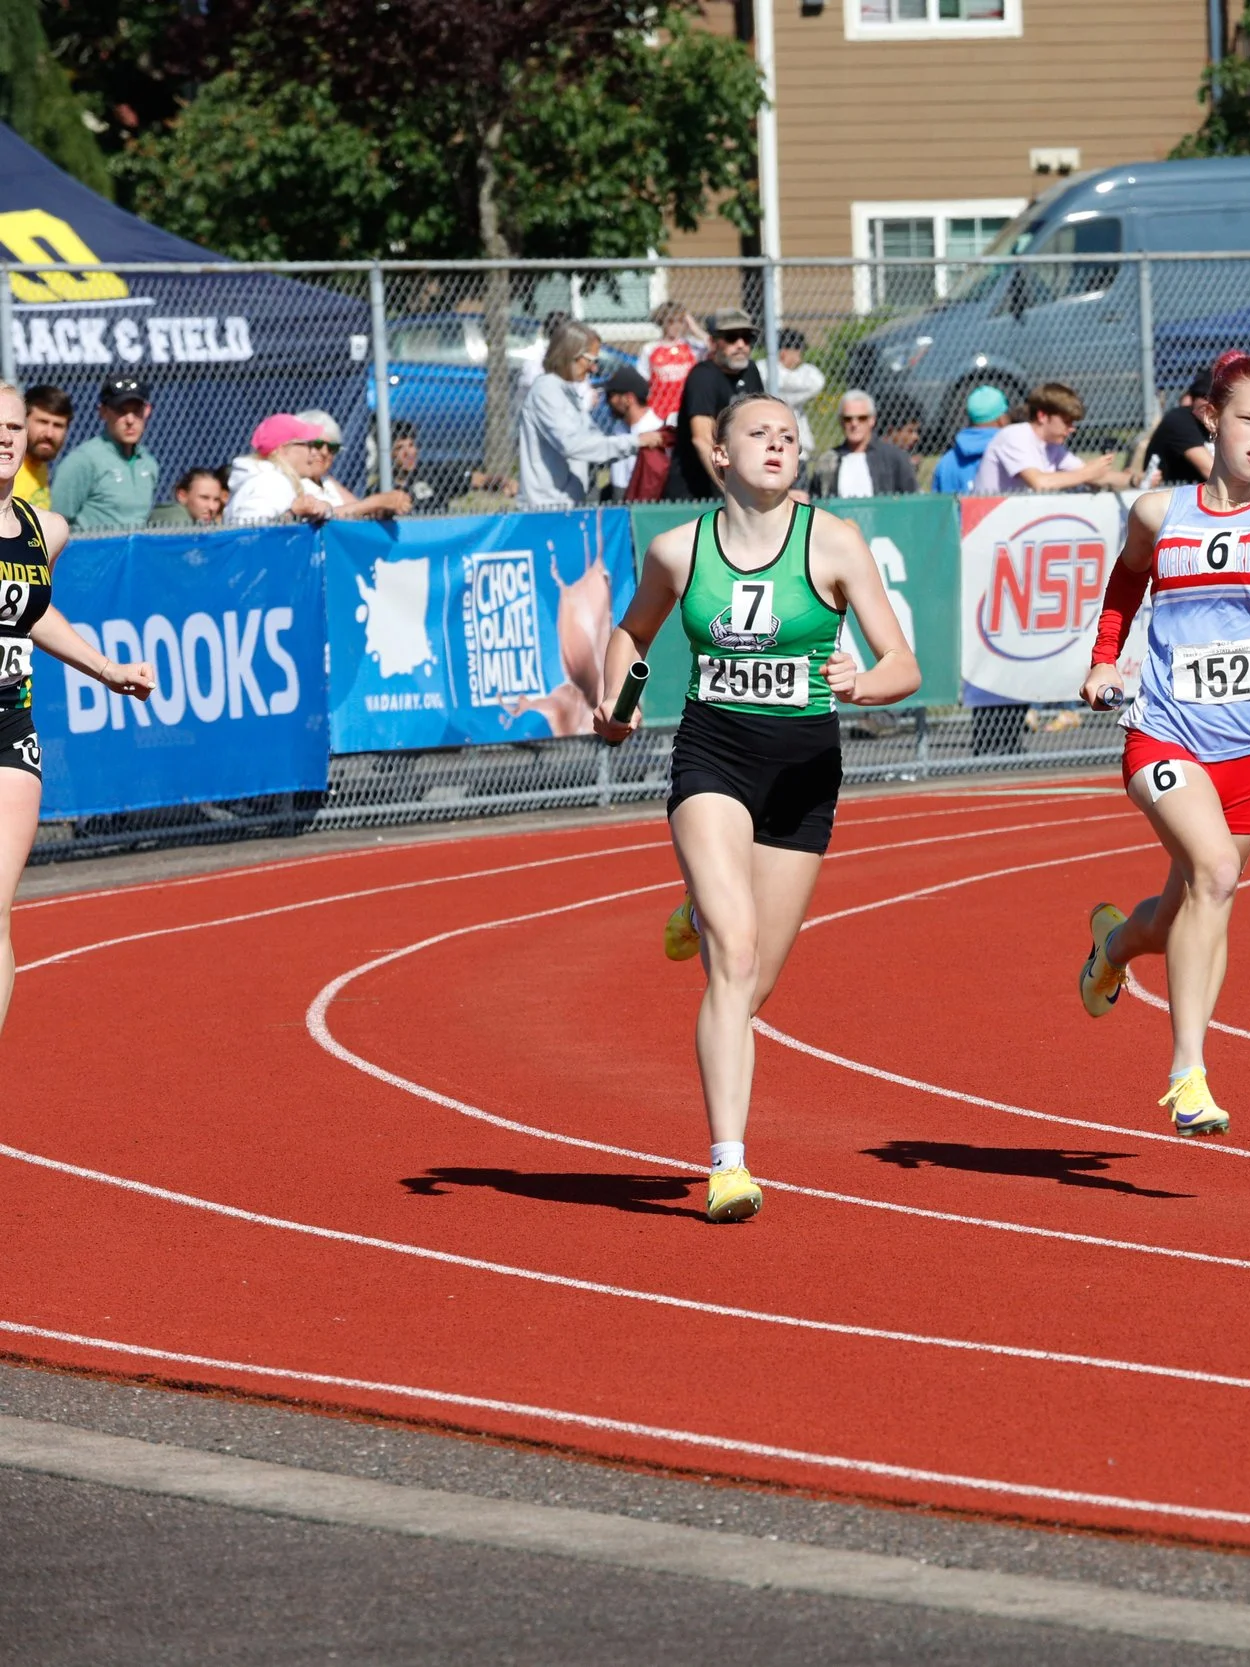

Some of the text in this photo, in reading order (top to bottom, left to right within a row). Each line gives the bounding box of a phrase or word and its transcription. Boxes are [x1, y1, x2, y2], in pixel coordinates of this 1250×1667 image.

[147, 316, 254, 363] FIELD
[1206, 531, 1232, 570] 6
[0, 583, 23, 622] 8
[477, 561, 530, 614] CHOC
[742, 585, 765, 630] 7
[985, 538, 1106, 637] NSP
[480, 602, 535, 650] OLATE
[64, 606, 300, 734] BROOKS
[483, 649, 539, 695] MILK
[708, 657, 796, 699] 2569
[1152, 760, 1177, 792] 6
